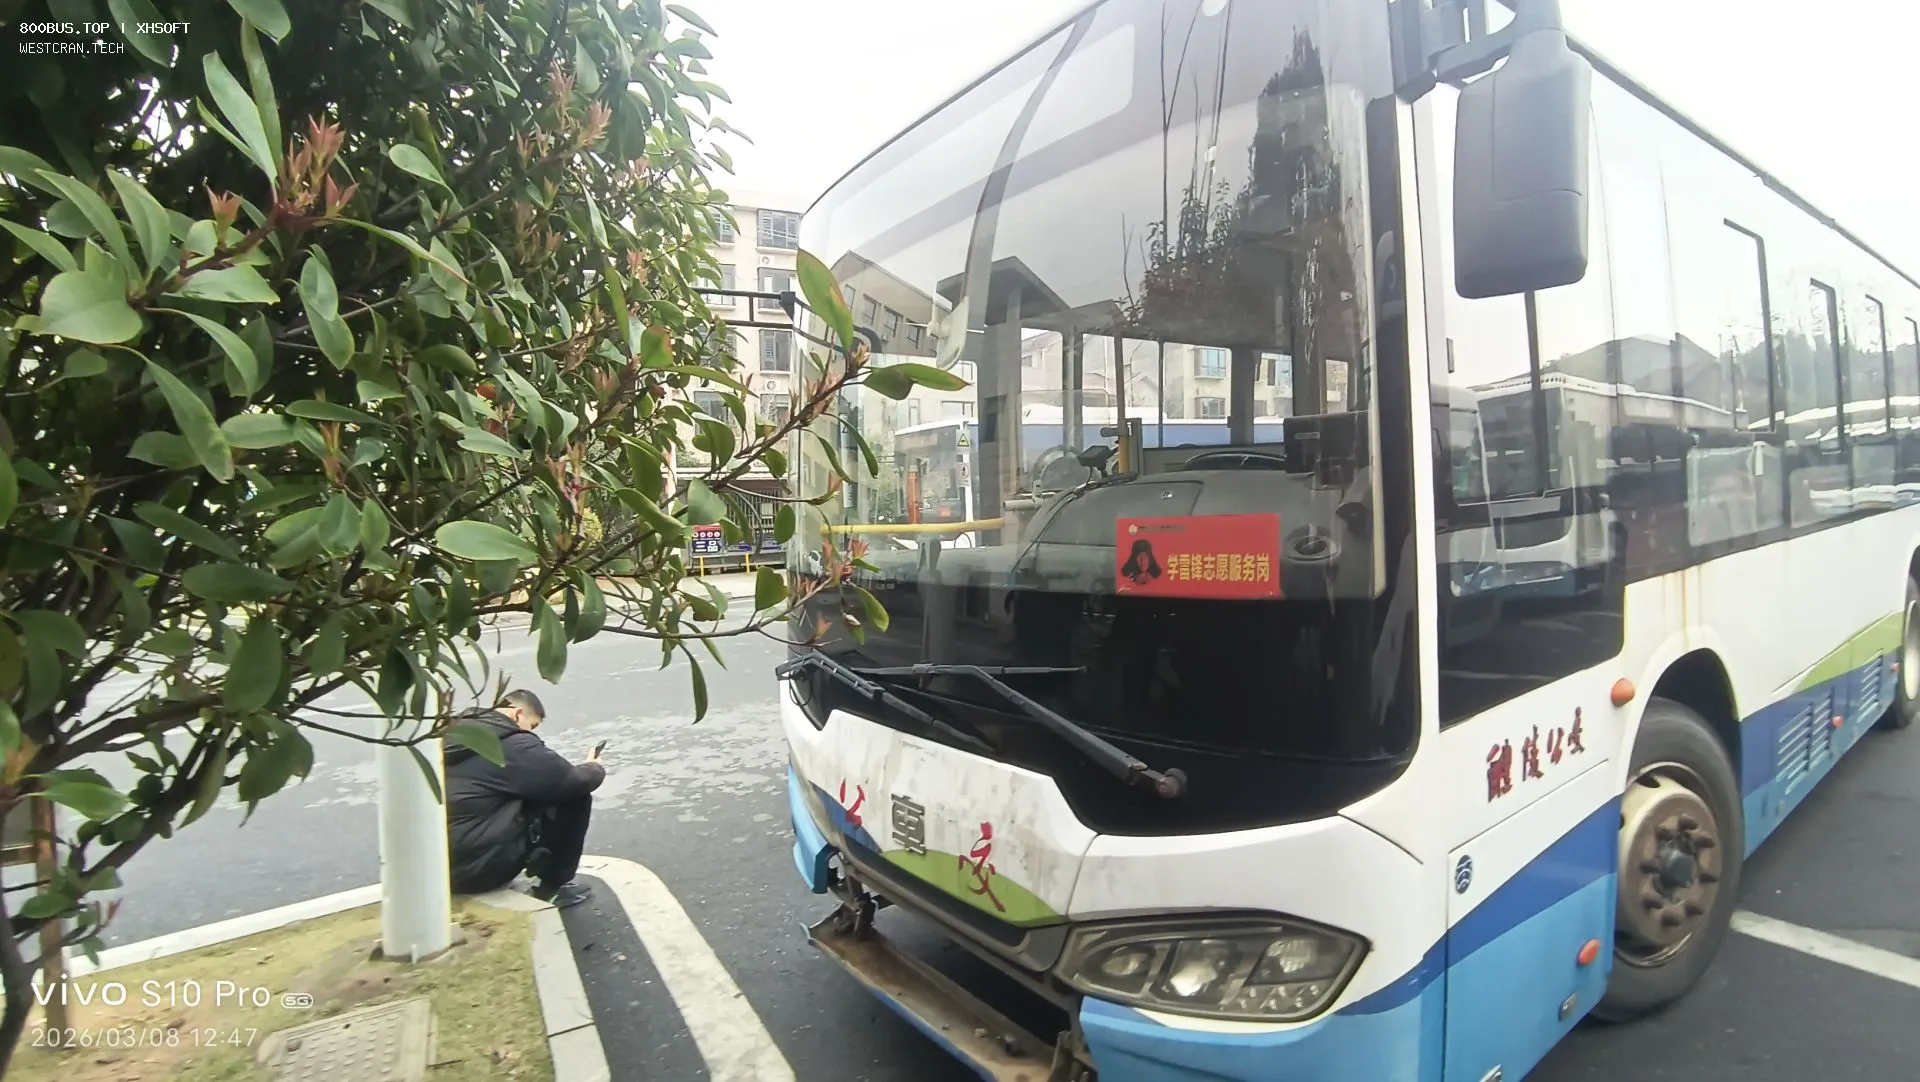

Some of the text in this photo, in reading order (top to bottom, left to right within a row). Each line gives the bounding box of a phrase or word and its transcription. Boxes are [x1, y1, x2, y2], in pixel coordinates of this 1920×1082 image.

[1167, 553, 1270, 583] 学雷锋志愿服务岗
